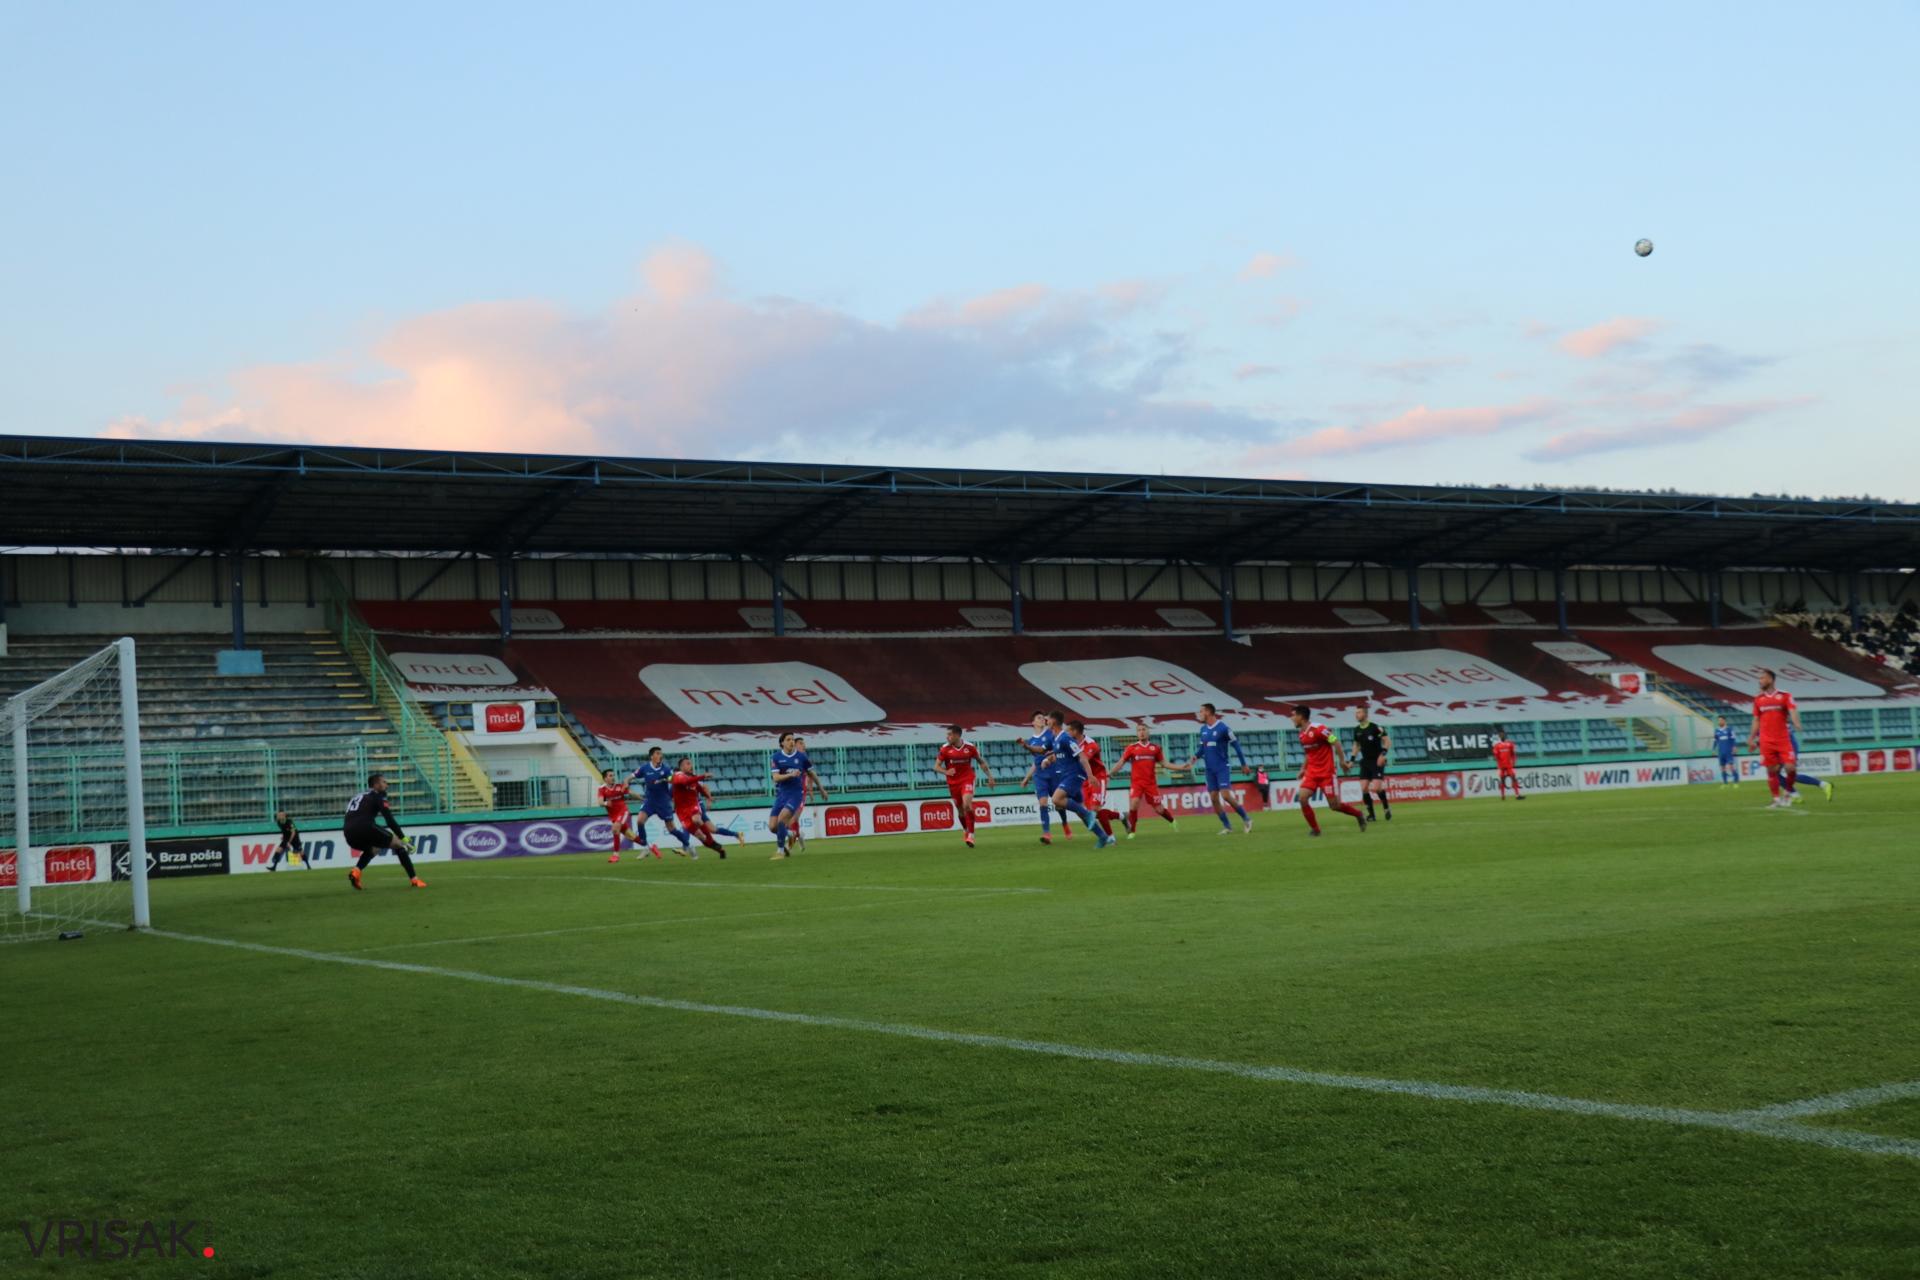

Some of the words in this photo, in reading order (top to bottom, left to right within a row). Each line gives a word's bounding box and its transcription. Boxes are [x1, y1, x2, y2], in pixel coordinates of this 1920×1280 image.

[681, 679, 848, 707] m:tel
[1060, 672, 1205, 702] m:tel
[489, 710, 521, 724] m:tel
[1427, 734, 1489, 752] KELME
[1543, 773, 1573, 788] Bank
[876, 811, 904, 824] m:tel
[924, 809, 951, 822] m:tel
[994, 805, 1037, 816] CENTRAL
[828, 814, 857, 827] m:tel
[159, 852, 187, 863] Brza
[190, 849, 223, 863] pošta
